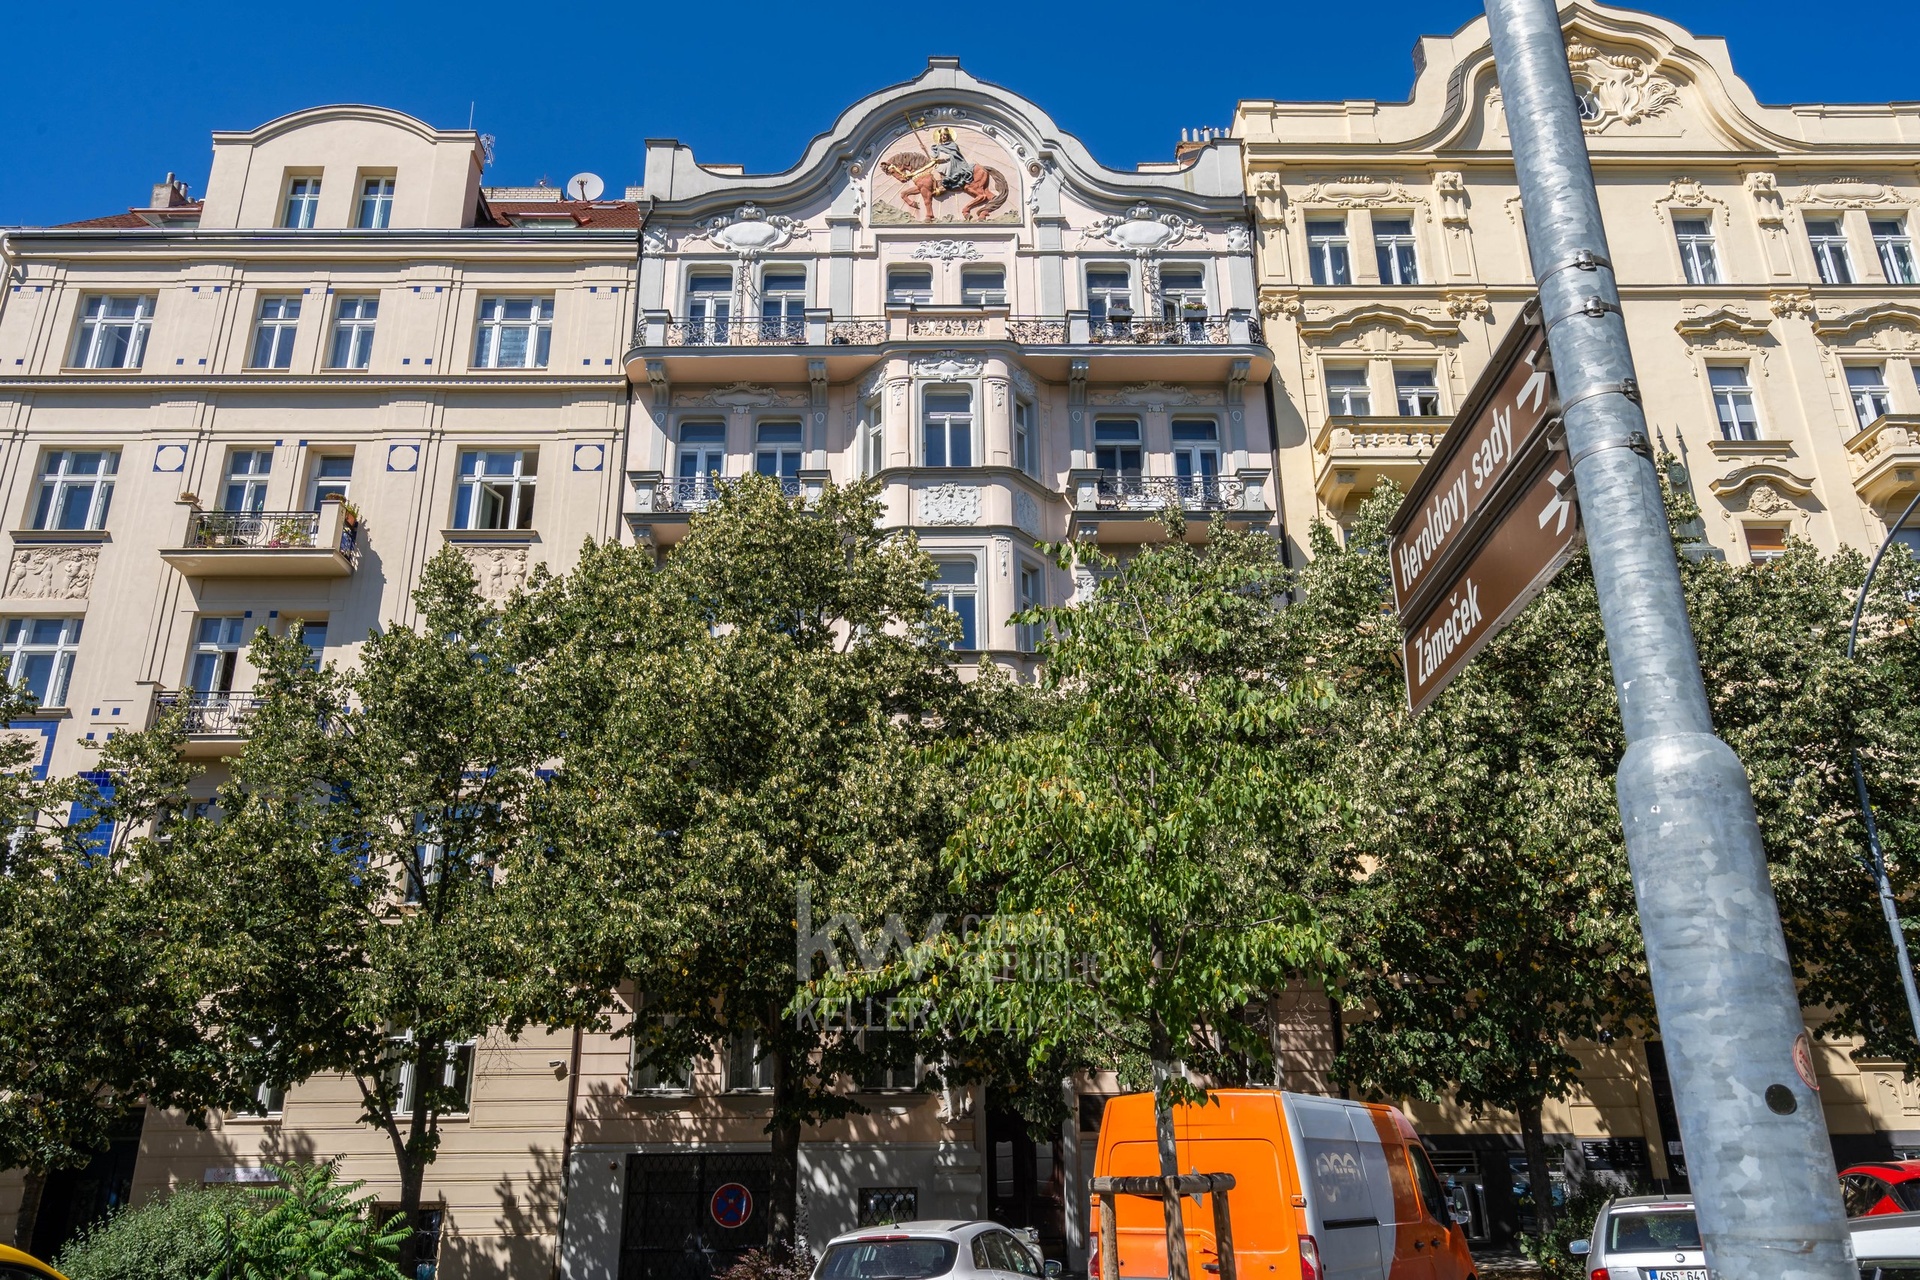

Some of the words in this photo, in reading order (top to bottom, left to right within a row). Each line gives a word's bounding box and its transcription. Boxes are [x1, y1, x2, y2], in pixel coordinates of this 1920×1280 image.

[1400, 469, 1468, 591] Heroldovy
[1472, 405, 1512, 490] sady
[1415, 578, 1482, 686] Zámeček
